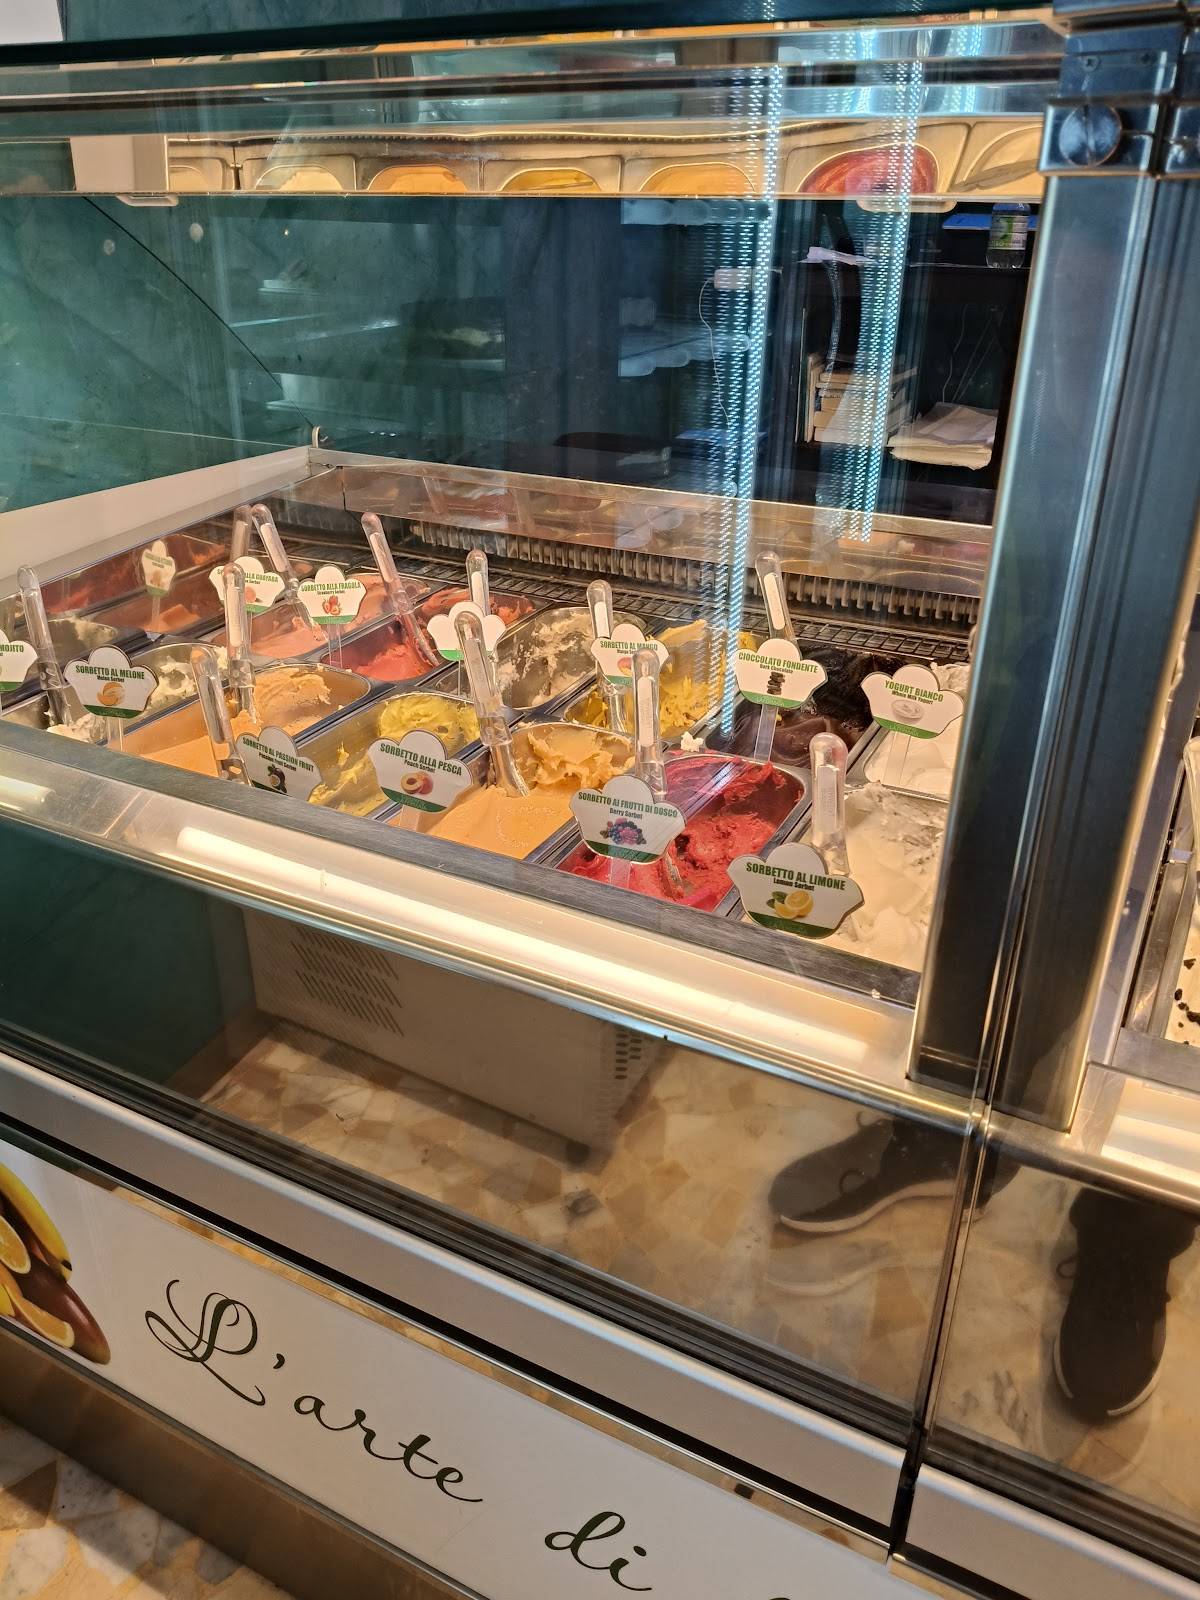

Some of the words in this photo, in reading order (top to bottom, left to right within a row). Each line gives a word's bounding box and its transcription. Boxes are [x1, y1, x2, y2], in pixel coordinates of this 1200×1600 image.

[301, 584, 326, 592] SORBETTO
[339, 581, 361, 589] FRAGOLA
[0, 644, 24, 652] MOJITO
[600, 641, 628, 649] SORBETTO
[637, 642, 658, 650] MANGO
[738, 652, 781, 666] CIOCCOLATO
[783, 660, 818, 673] FONDENTE
[771, 665, 794, 673] Chocolate
[76, 665, 109, 676] SORBETTO
[110, 668, 119, 677] AL
[120, 670, 144, 680] MELONE
[885, 680, 915, 693] YOGURT
[915, 688, 944, 702] BIANCO
[243, 737, 268, 754] SORBETTO
[269, 748, 275, 756] AL
[276, 750, 298, 766] PASSION
[380, 743, 418, 761] SORBETTO
[420, 755, 437, 768] ALLA
[438, 760, 462, 775] PESCA
[404, 760, 419, 768] Peach
[420, 764, 436, 773] Sorbet
[578, 792, 612, 805] SORBETTO
[621, 800, 644, 811] FRUTTI
[645, 804, 652, 813] DI
[654, 806, 678, 818] BOSCO
[610, 808, 624, 816] Berry
[625, 810, 643, 819] Sorbet
[746, 862, 794, 880] SORBETTO
[796, 872, 806, 883] AL
[809, 874, 846, 890] LIMONE
[773, 878, 794, 887] Lemon
[794, 882, 815, 891] Sorbet
[145, 1280, 483, 1503] L'arte
[544, 1511, 652, 1591] di
